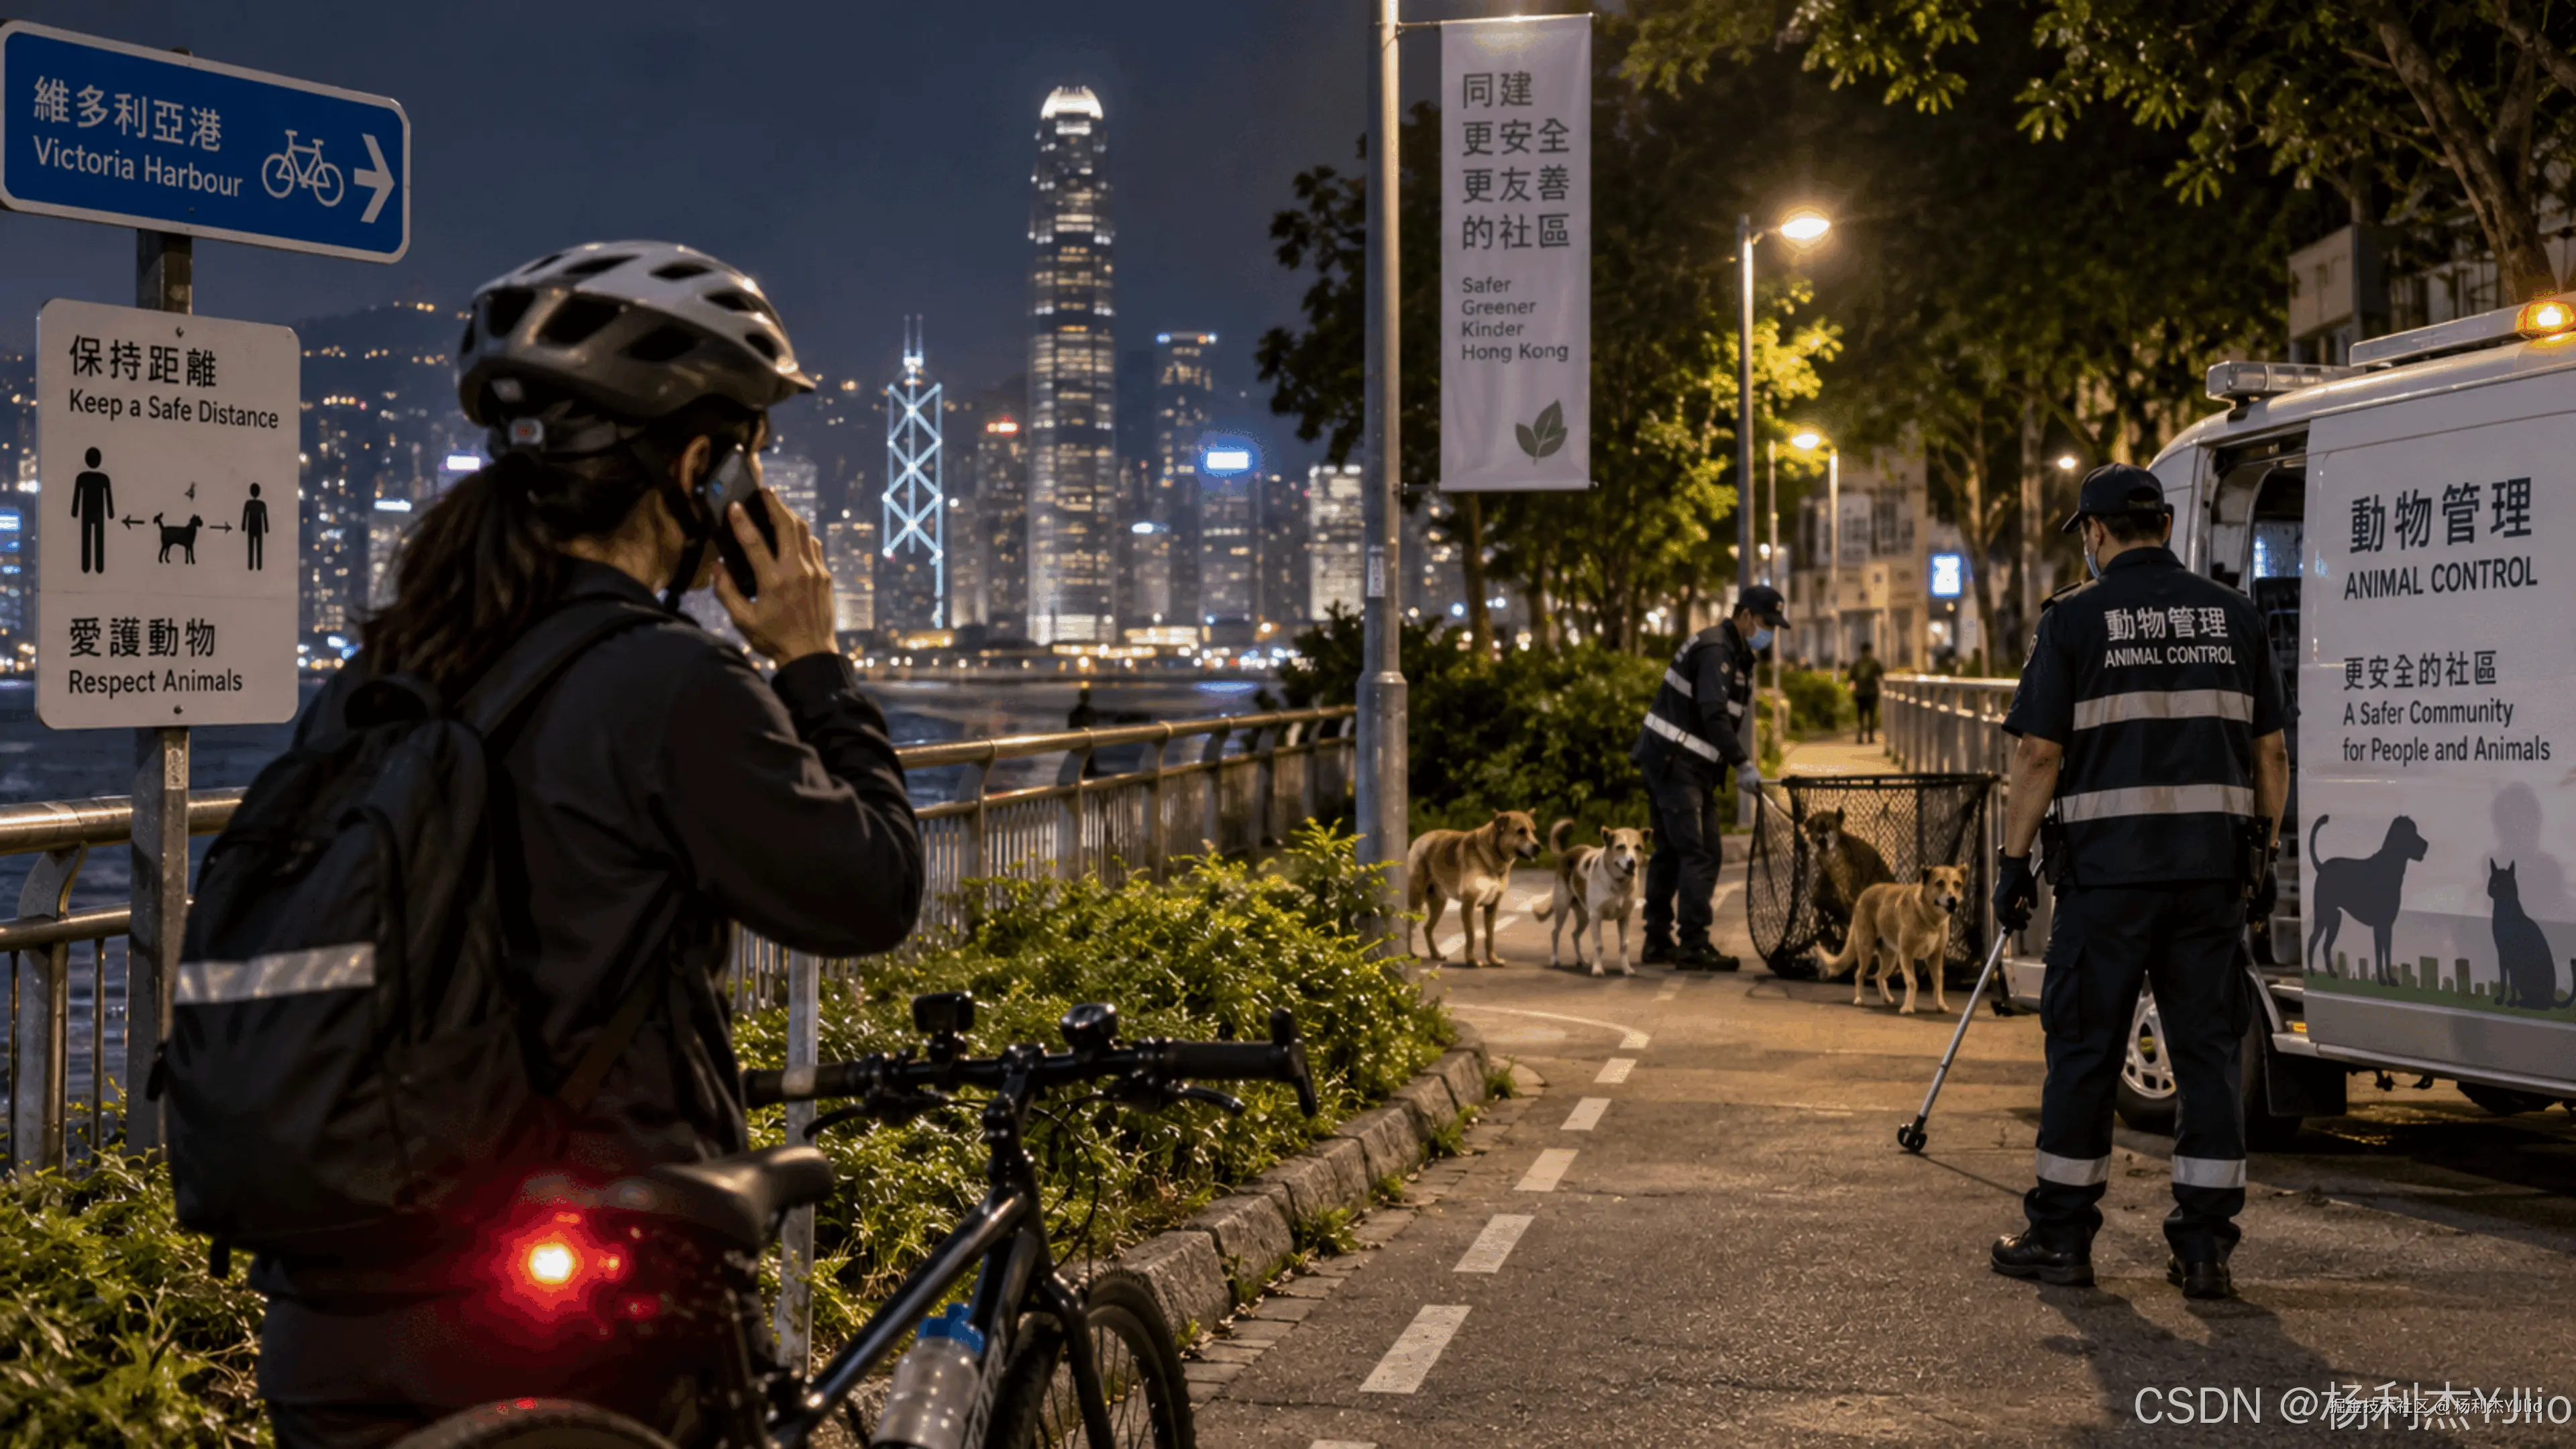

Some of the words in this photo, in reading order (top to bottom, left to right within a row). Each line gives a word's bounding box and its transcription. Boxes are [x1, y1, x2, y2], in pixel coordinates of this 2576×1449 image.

[1463, 72, 1532, 109] 同建
[34, 76, 222, 152] 維多利亞港
[1462, 118, 1570, 156] 更安全
[33, 136, 134, 180] Victoria
[144, 155, 243, 197] Harbour
[1462, 164, 1570, 203] 更友善
[1462, 213, 1570, 250] 的社區
[1462, 276, 1511, 293] Safer
[1462, 299, 1536, 315] Greener
[1462, 321, 1524, 337] Kinder
[69, 335, 217, 388] 保持距離
[1462, 343, 1512, 363] Hong
[1519, 343, 1568, 362] Kong
[69, 388, 123, 421] Keep
[129, 400, 141, 417] a
[148, 396, 192, 421] Safe
[199, 400, 279, 429] Distance
[2350, 477, 2532, 553] 動物管理
[2345, 567, 2423, 600] ANIMAL
[2431, 556, 2537, 593] CONTROL
[69, 617, 215, 657] 愛護動物
[2104, 606, 2228, 641] 動物管理
[2104, 647, 2163, 668] ANIMAL
[2167, 645, 2236, 665] CONTROL
[2344, 651, 2497, 690] 更安全的社區
[69, 670, 156, 698] Respect
[163, 669, 243, 692] Animals
[2343, 702, 2355, 725] A
[2361, 701, 2404, 724] Safer
[2410, 698, 2514, 727] Community
[2343, 737, 2365, 761] for
[2371, 737, 2428, 766] People
[2435, 736, 2467, 761] and
[2474, 735, 2551, 761] Animals
